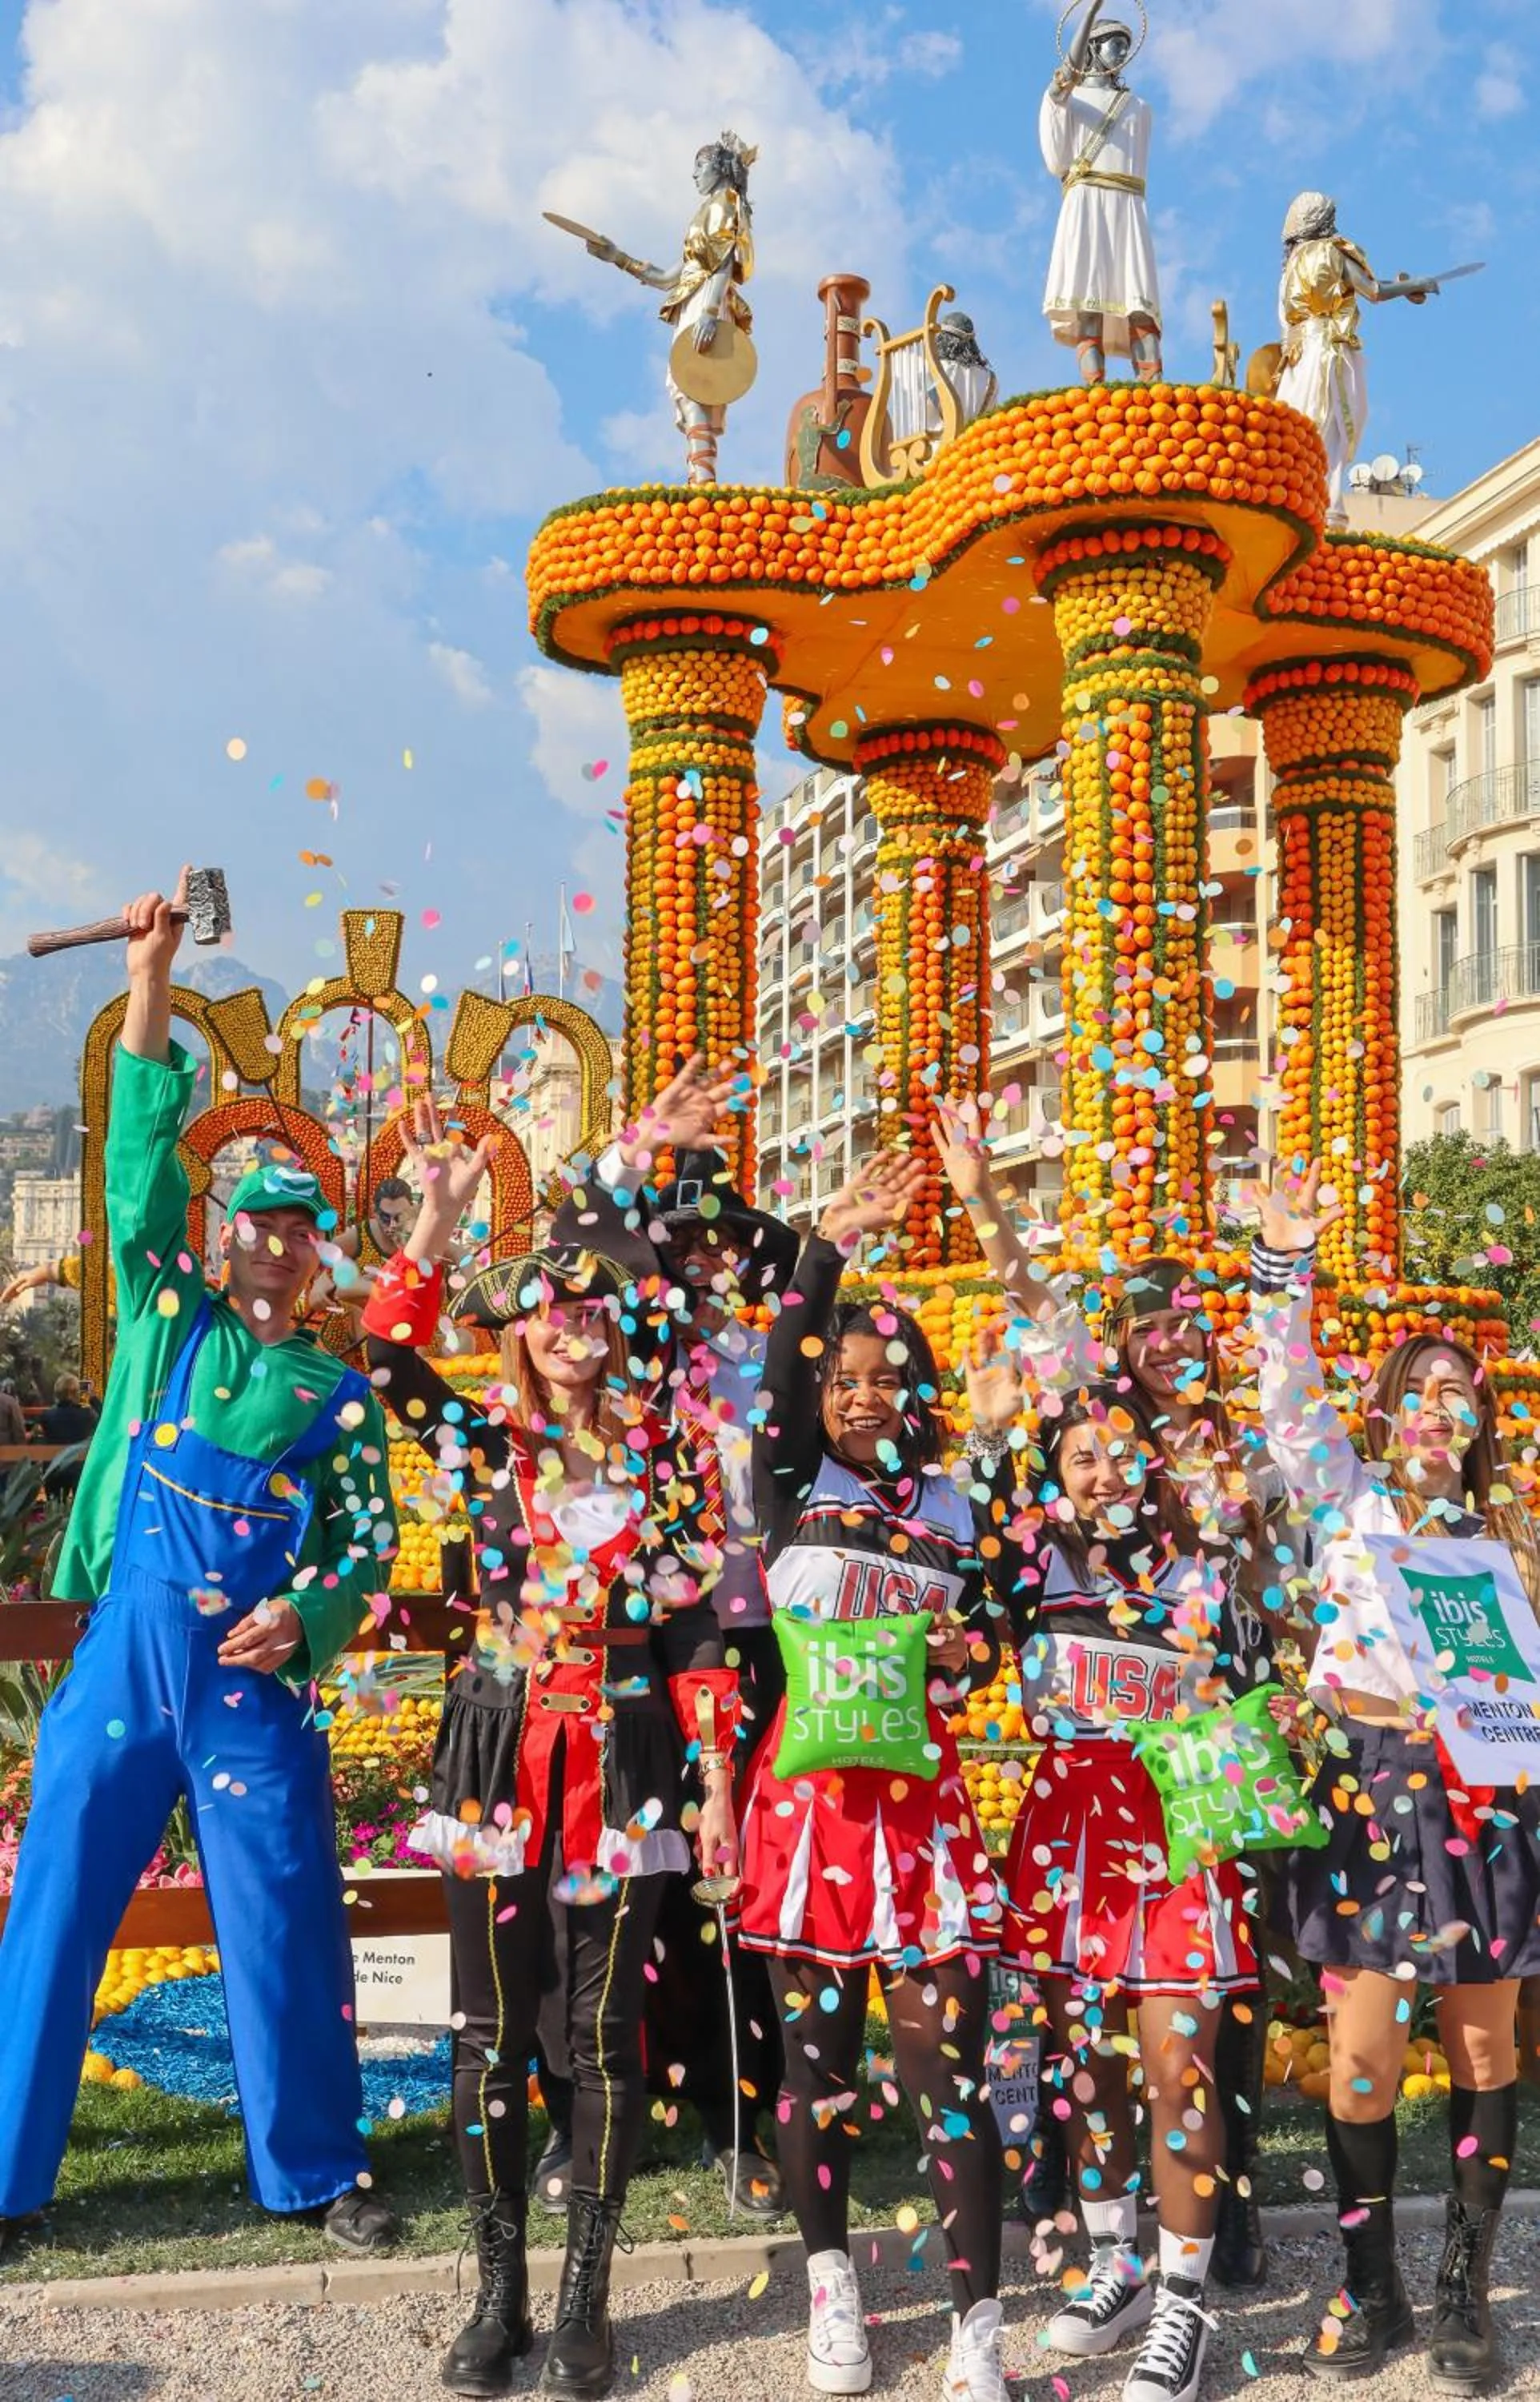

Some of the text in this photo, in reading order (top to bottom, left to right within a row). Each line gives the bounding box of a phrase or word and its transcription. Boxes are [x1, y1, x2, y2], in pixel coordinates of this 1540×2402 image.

[833, 1560, 948, 1620] USA
[1430, 1591, 1488, 1624] ibis
[808, 1641, 907, 1700] ibis
[1071, 1650, 1181, 1723] USA
[1464, 1701, 1536, 1719] MENTON
[1165, 1727, 1270, 1789] ibs
[363, 1951, 415, 1965] Menton
[372, 1970, 403, 1984] Nice
